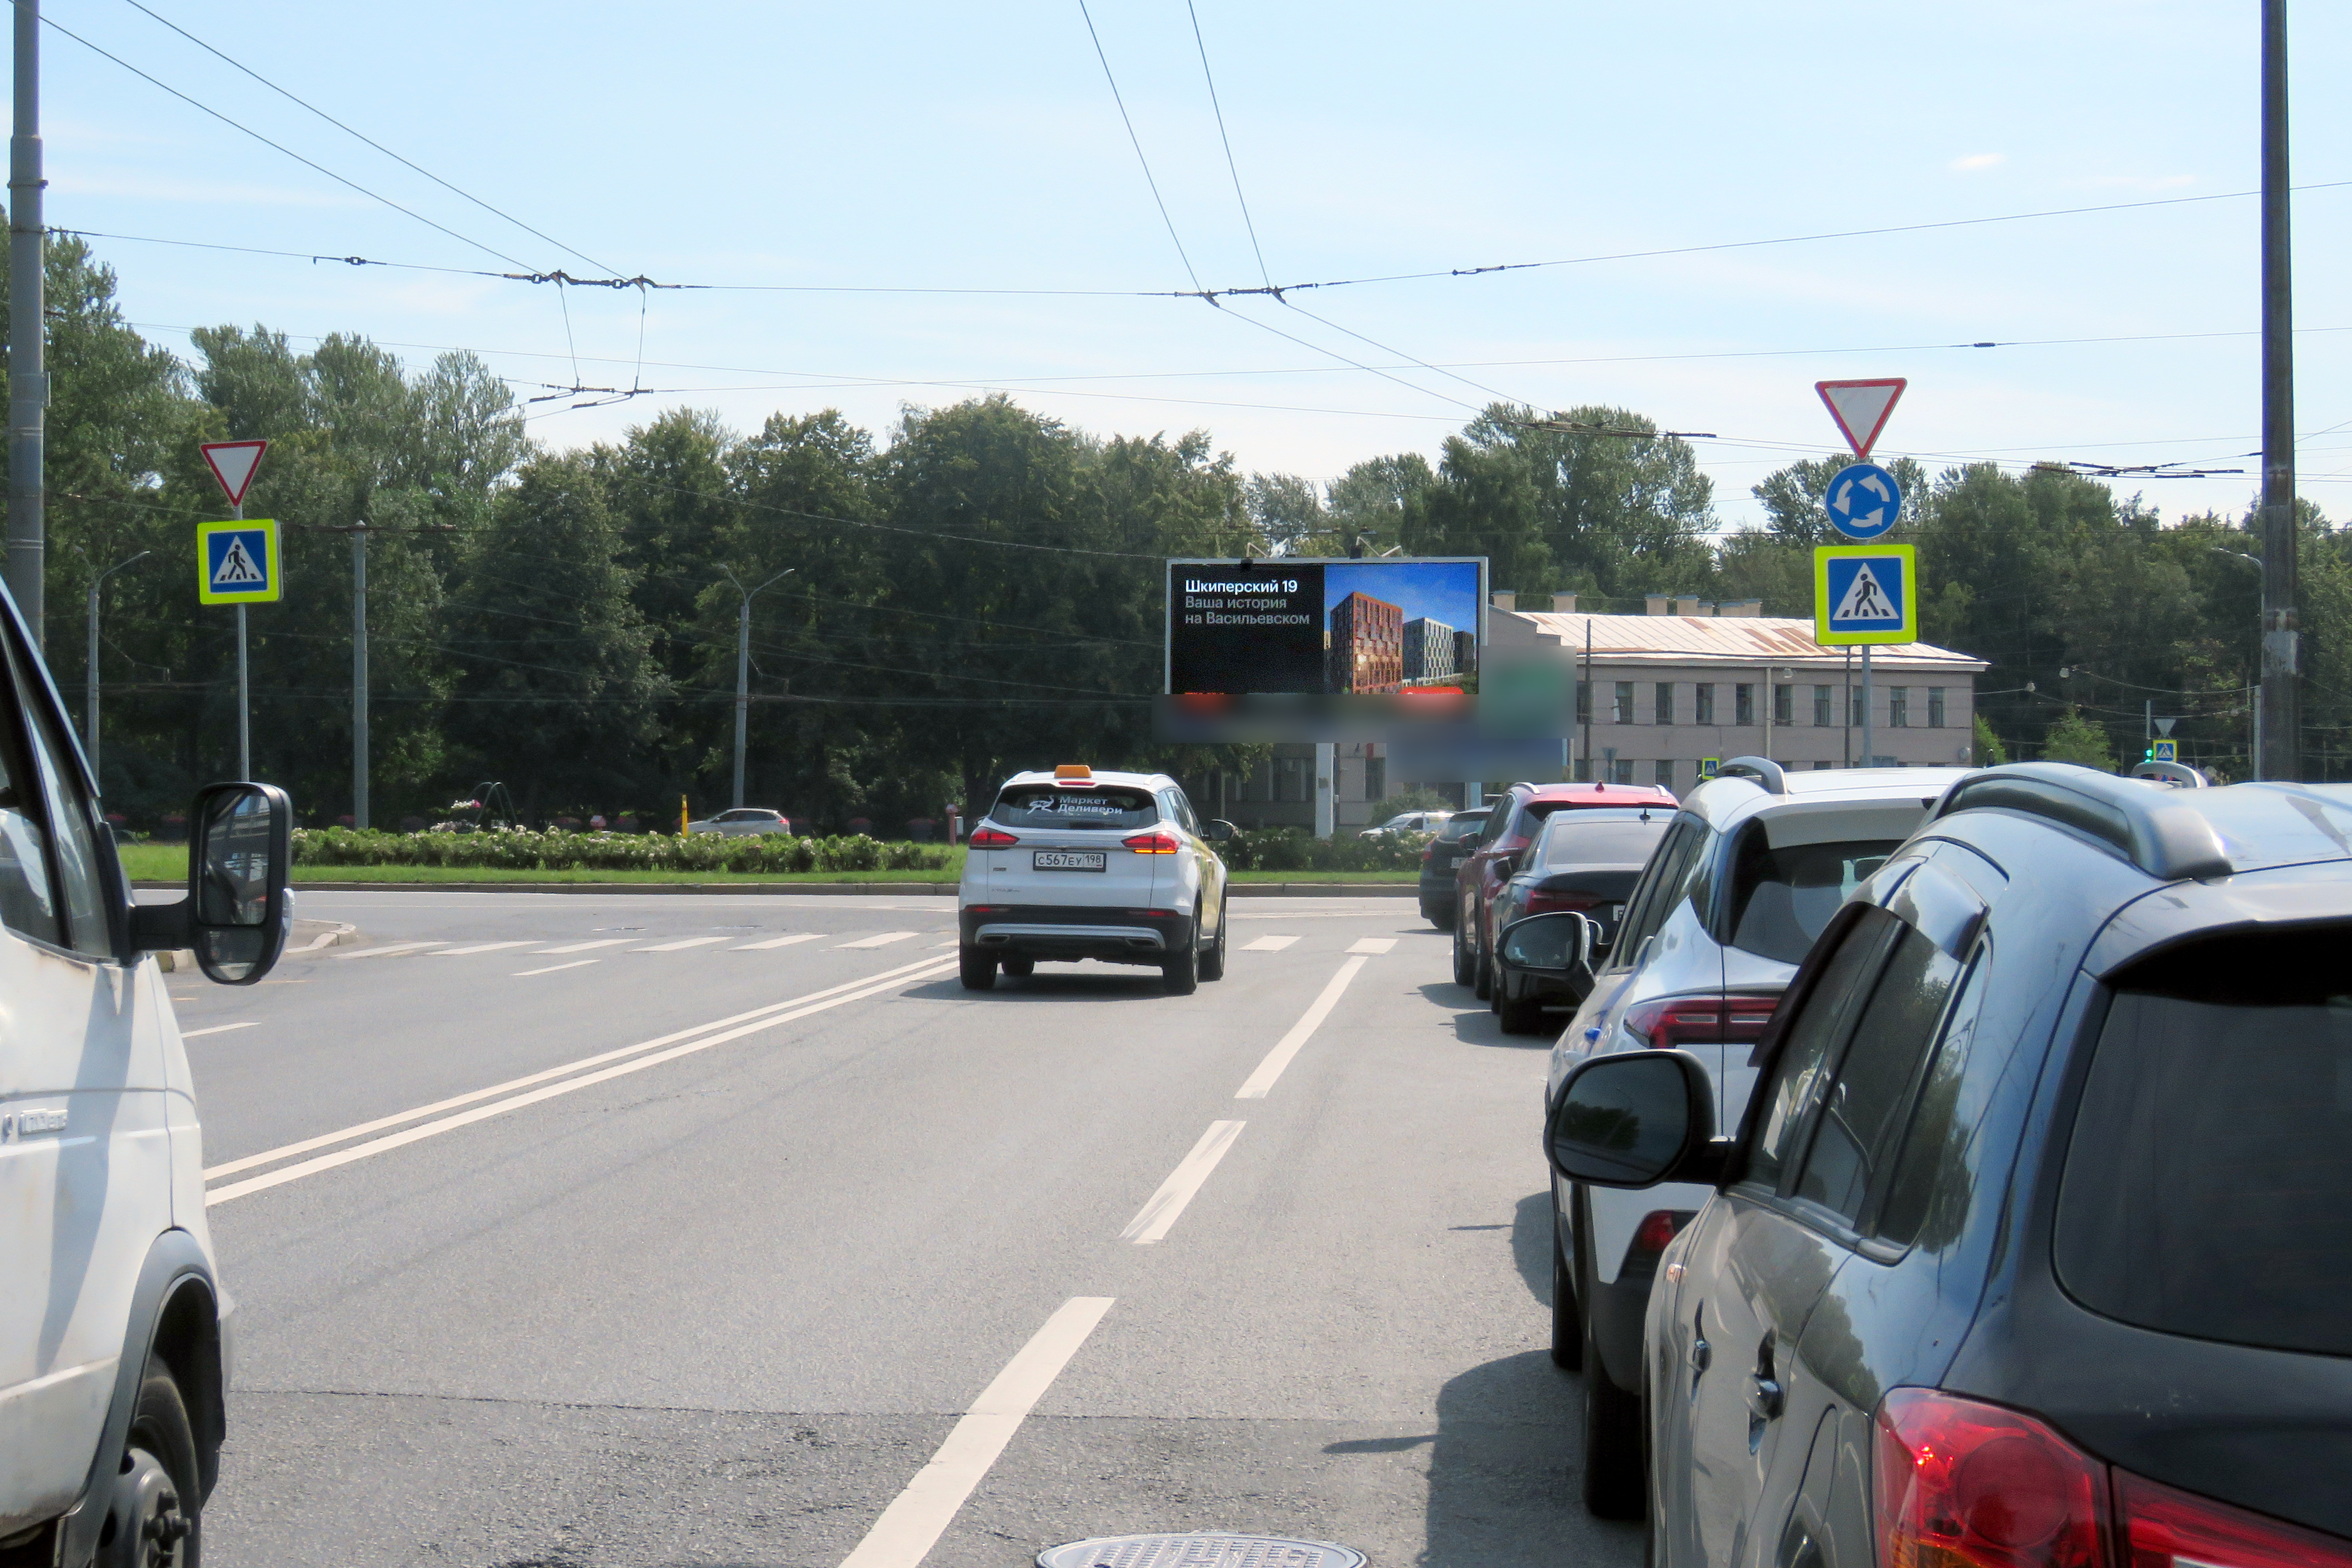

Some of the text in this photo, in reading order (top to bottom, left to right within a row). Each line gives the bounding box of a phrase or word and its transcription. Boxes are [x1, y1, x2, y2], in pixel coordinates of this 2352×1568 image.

[1185, 579, 1298, 595] Шкиперский 19
[1185, 596, 1287, 610] Ваша история
[1185, 611, 1310, 625] на Васильевском
[1060, 796, 1108, 805] Маркет
[1058, 804, 1122, 815] Деливери
